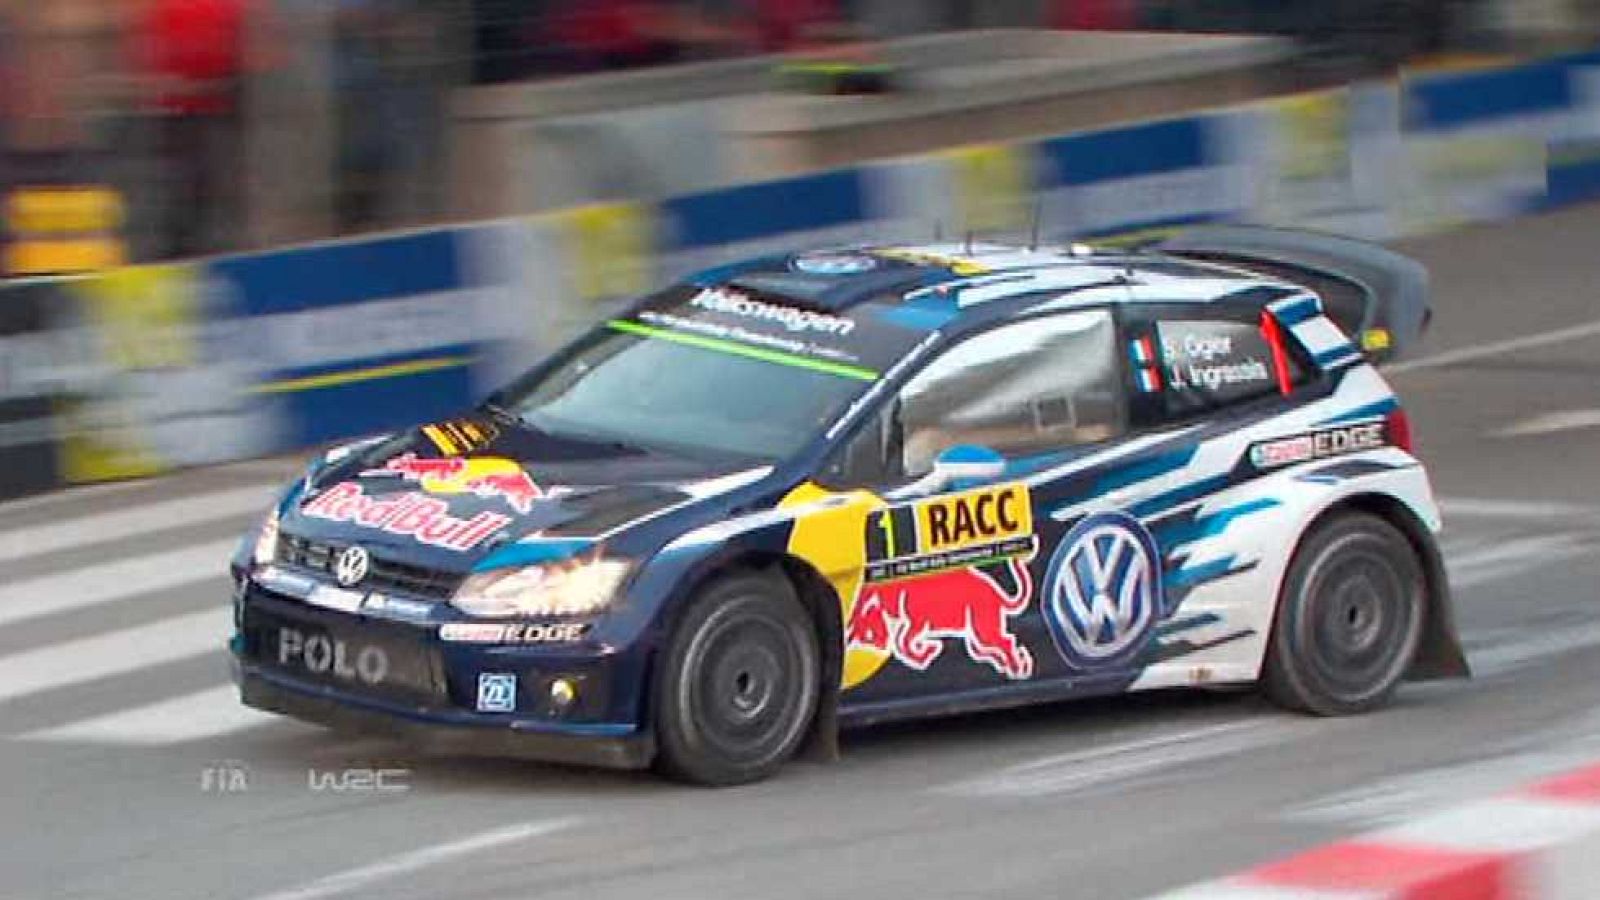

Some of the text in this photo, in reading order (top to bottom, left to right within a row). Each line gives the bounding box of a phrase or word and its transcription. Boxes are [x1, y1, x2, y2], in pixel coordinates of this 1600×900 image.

[1315, 424, 1384, 457] EDGE
[877, 507, 896, 560] 1
[927, 490, 1019, 547] RACC
[278, 626, 390, 684] POLO
